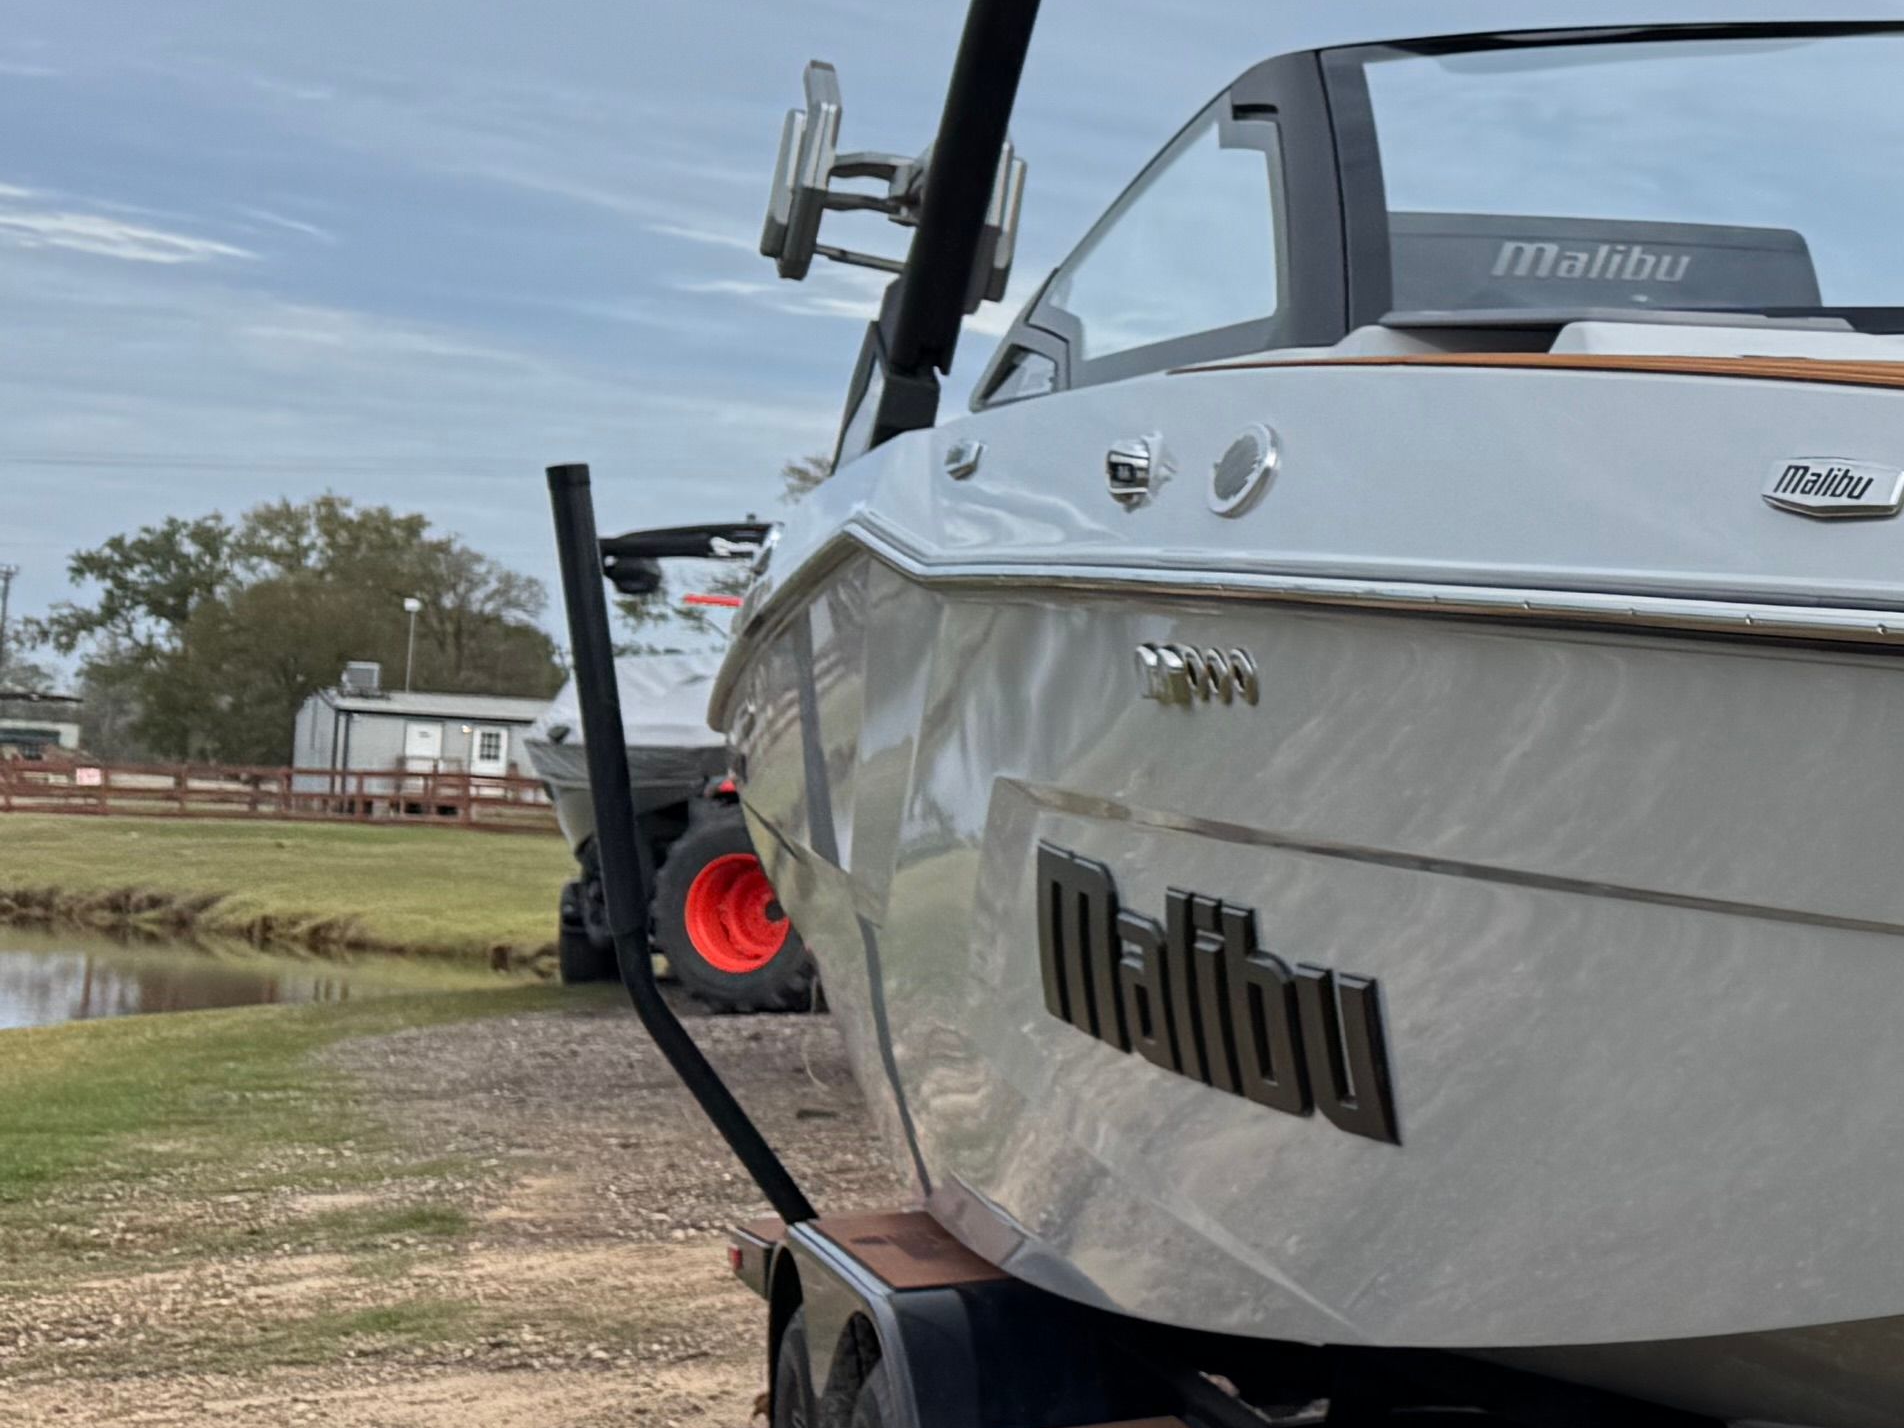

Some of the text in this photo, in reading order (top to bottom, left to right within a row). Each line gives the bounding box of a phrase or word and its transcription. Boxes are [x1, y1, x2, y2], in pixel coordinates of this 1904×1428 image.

[1491, 241, 1691, 282] Malibu
[1773, 464, 1874, 500] Malibu
[1036, 837, 1403, 1147] Malibu
